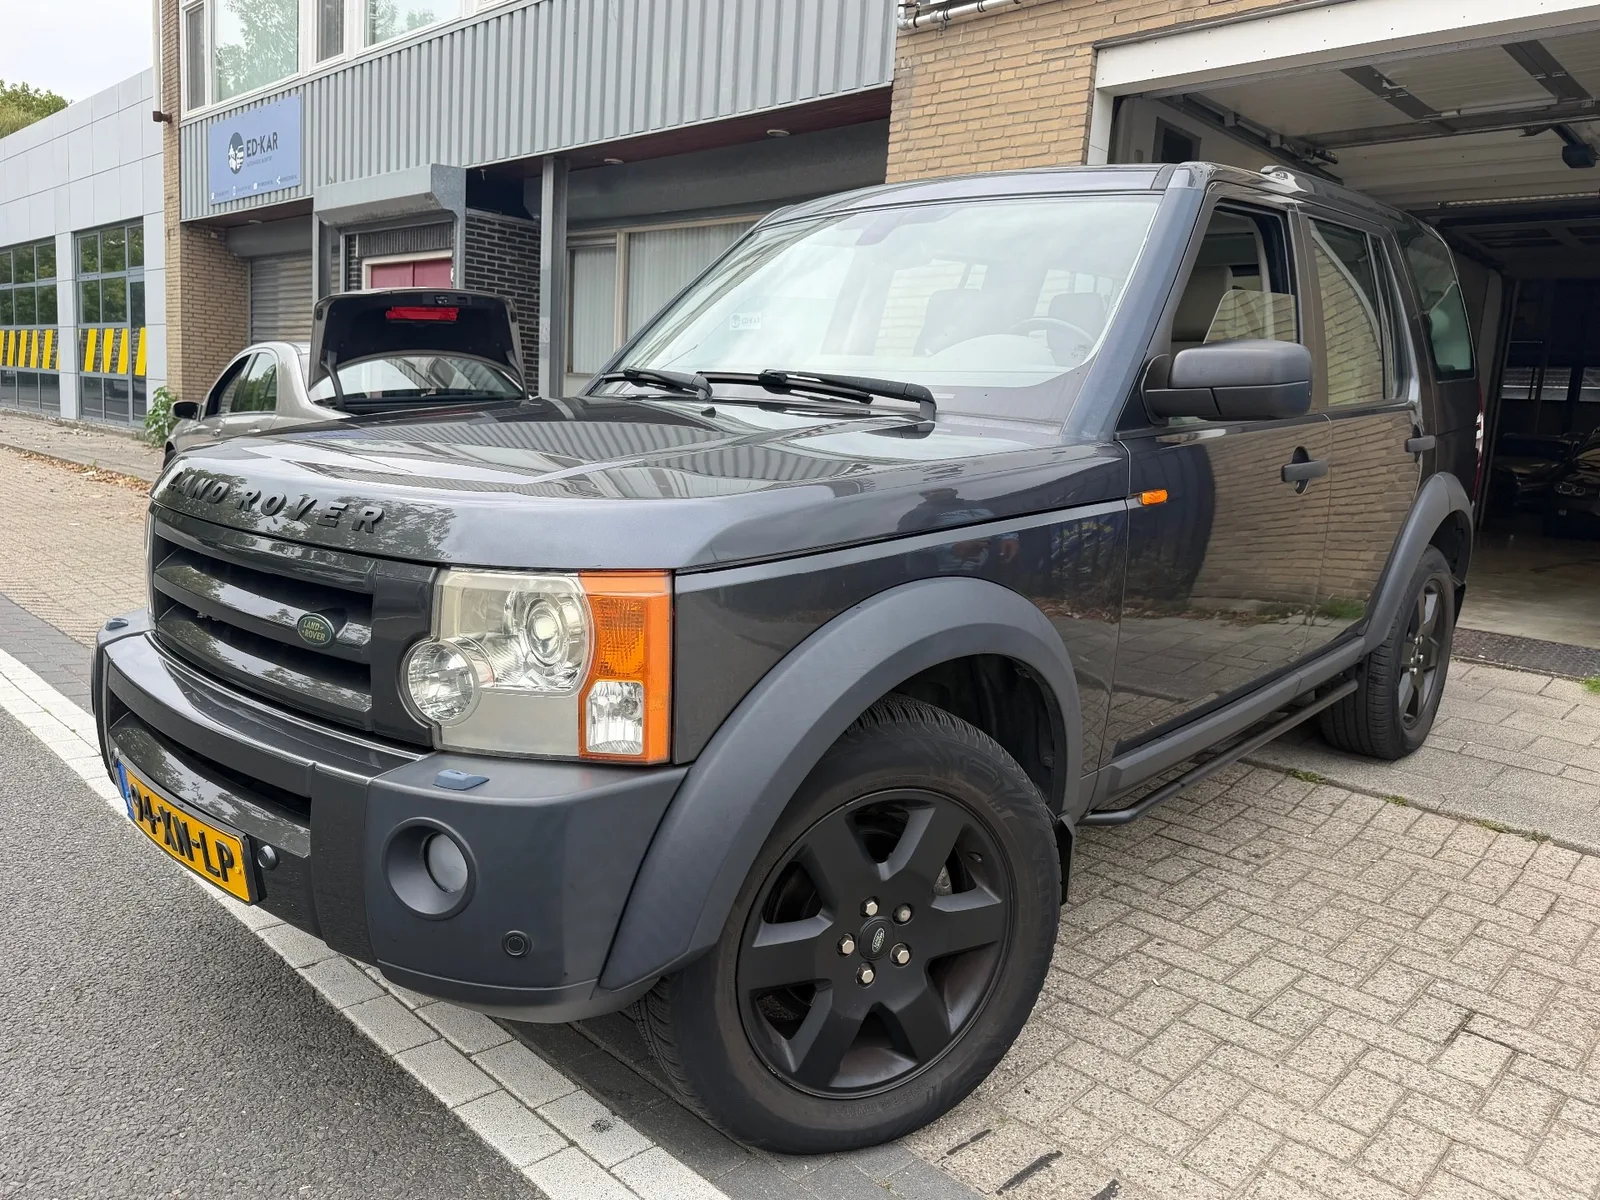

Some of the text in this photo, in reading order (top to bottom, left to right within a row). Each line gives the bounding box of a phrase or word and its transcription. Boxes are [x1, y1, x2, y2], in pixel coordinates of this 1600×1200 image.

[246, 131, 279, 158] ED-KAR
[236, 489, 384, 534] ROVER
[129, 783, 235, 883] 94-XN-LP
